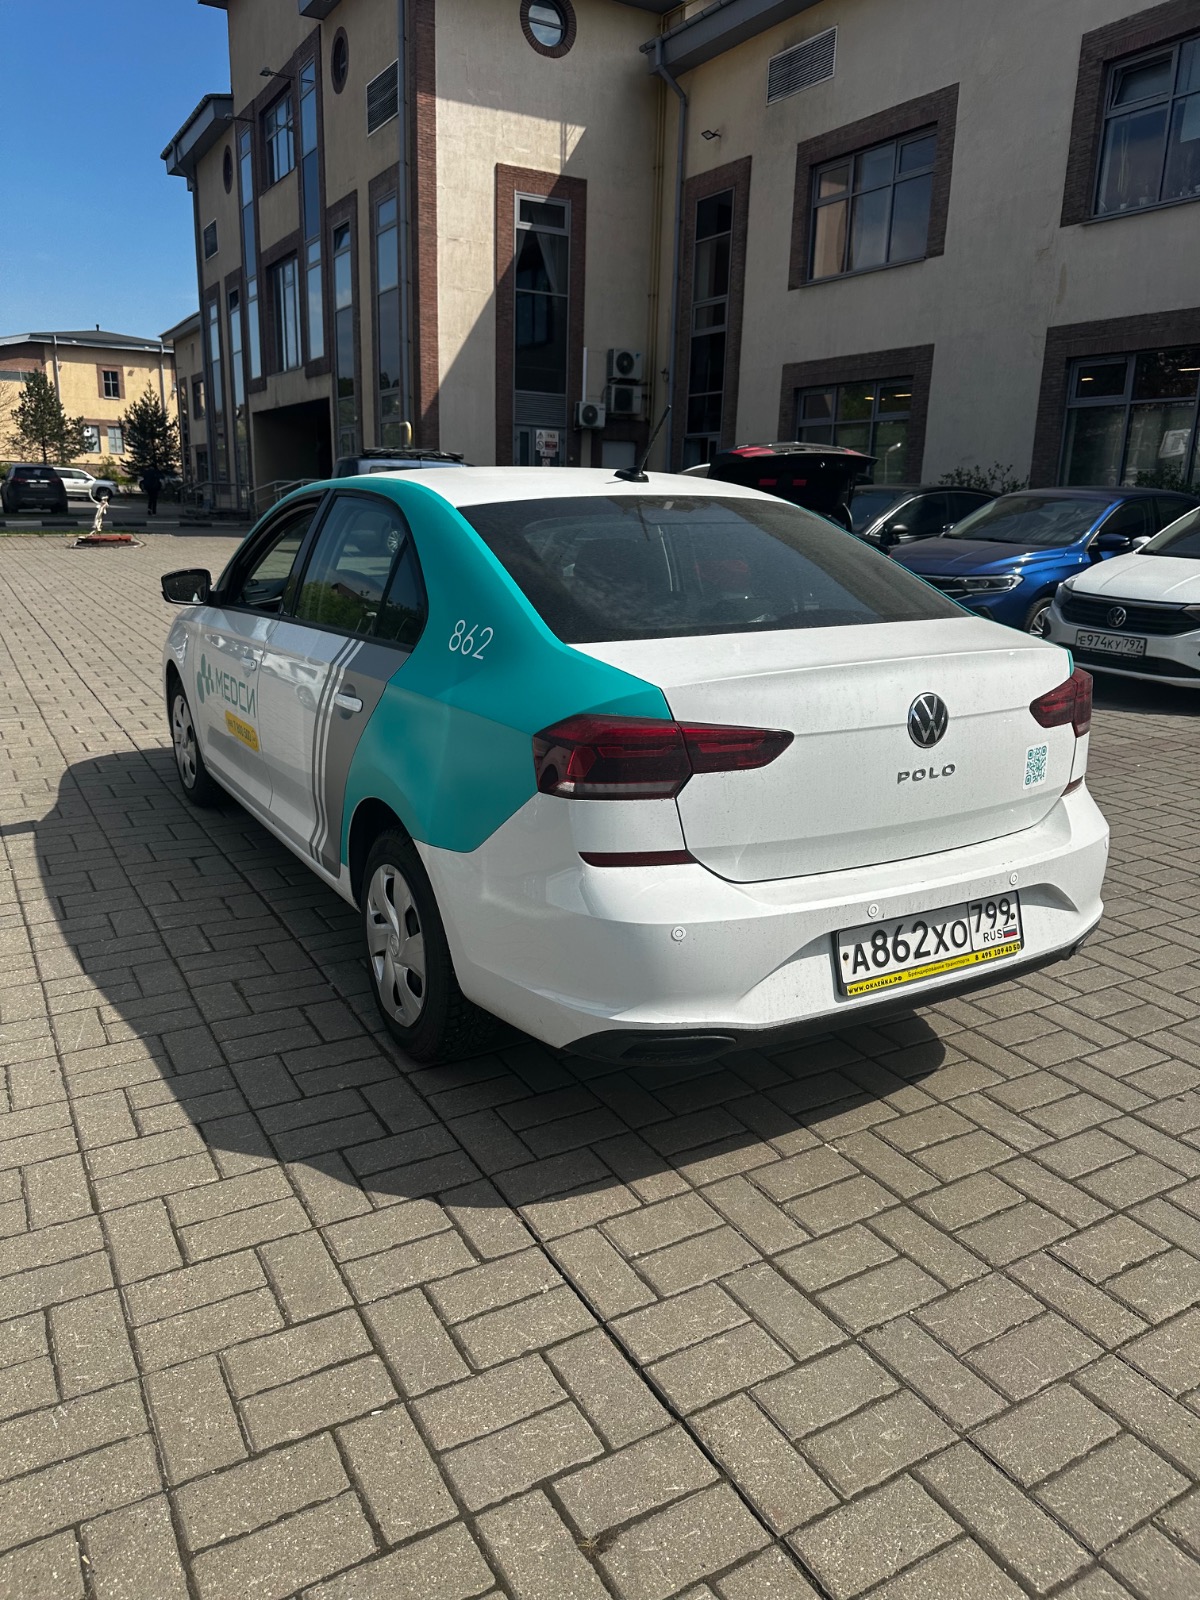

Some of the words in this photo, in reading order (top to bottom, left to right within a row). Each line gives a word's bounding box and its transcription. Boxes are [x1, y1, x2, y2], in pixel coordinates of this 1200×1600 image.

[449, 619, 494, 660] 862
[1124, 638, 1141, 649] 797
[897, 764, 956, 785] POLO
[971, 898, 1011, 933] 799
[983, 926, 1003, 943] RUS
[981, 951, 992, 960] 495
[994, 948, 1004, 956] 109
[1013, 943, 1021, 951] 50
